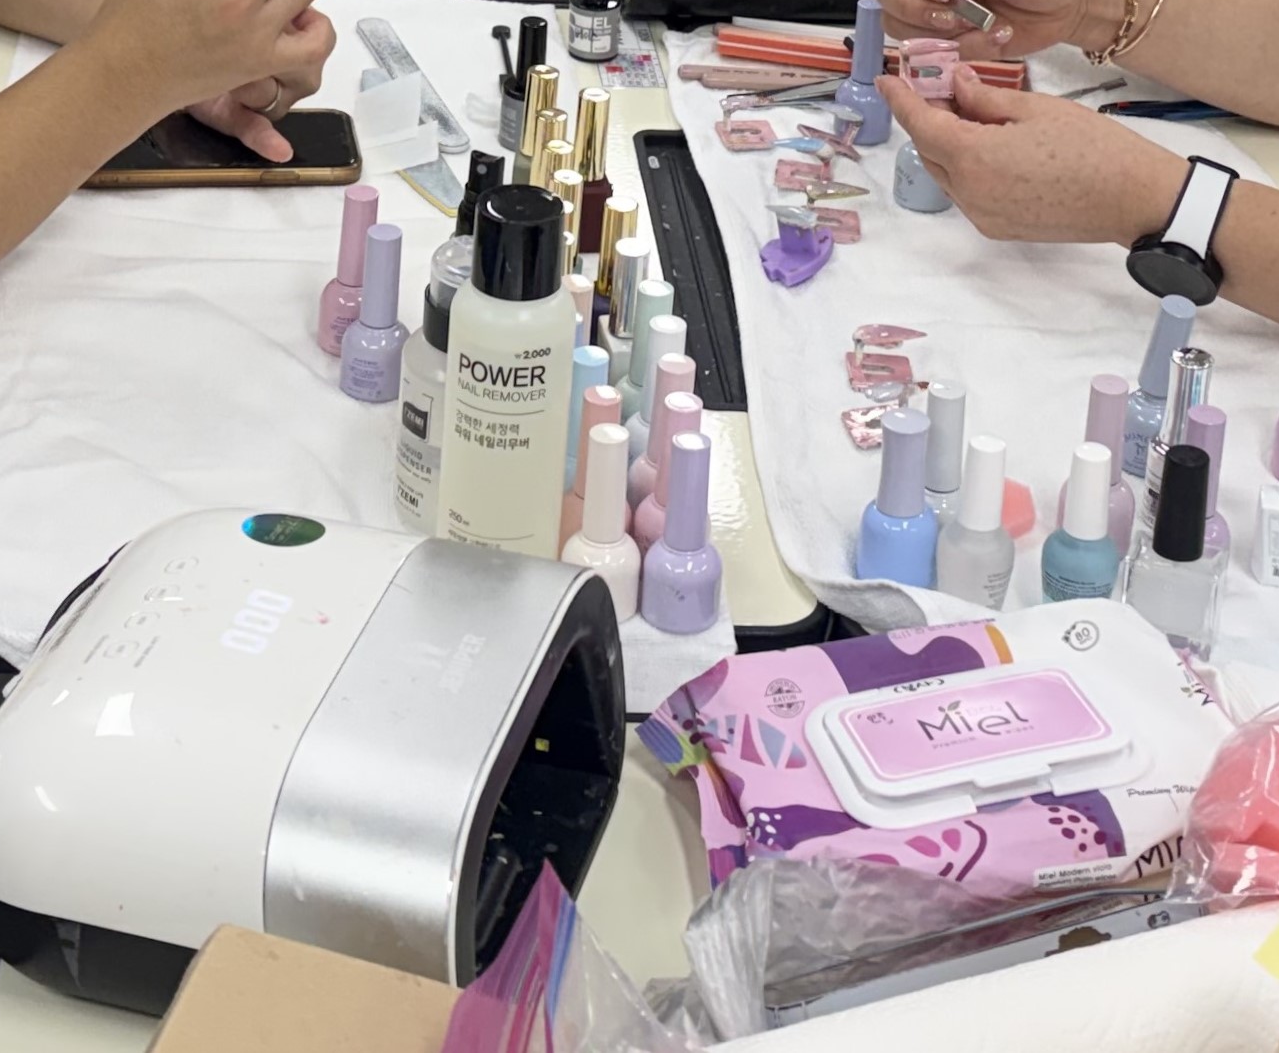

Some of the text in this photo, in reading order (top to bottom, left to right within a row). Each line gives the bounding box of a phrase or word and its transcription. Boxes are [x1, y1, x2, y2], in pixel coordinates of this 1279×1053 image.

[458, 353, 546, 387] POWER
[457, 377, 546, 403] NAIL REMOVER
[456, 409, 519, 436] 강력한 세정력
[474, 433, 530, 450] 네일리무버
[916, 700, 1029, 741] Miel
[1059, 867, 1090, 877] Modern
